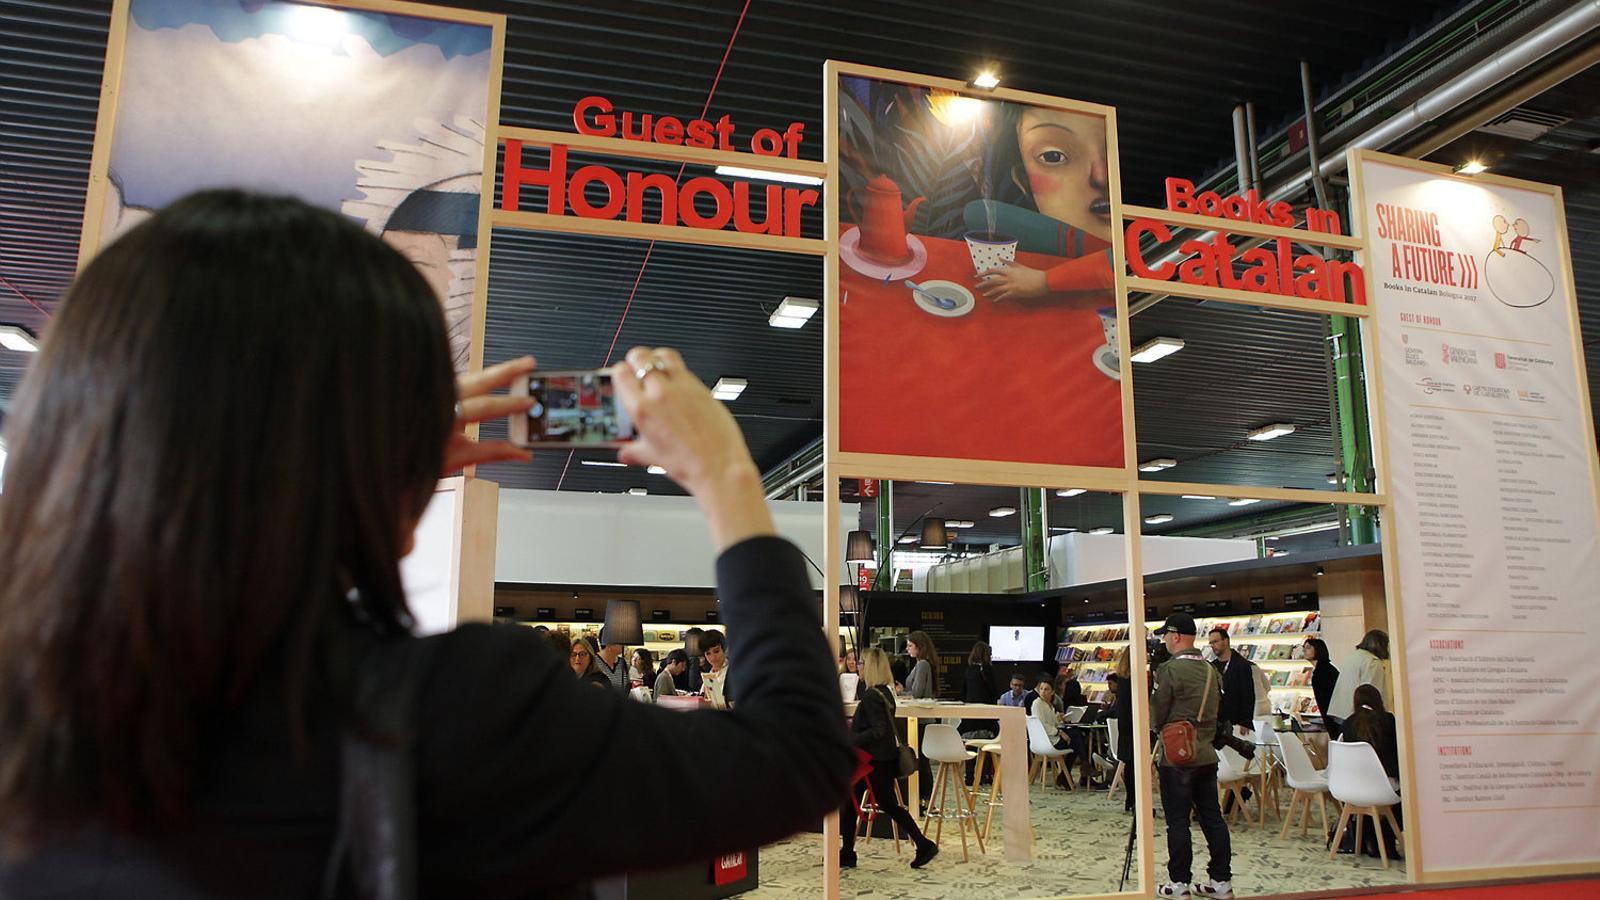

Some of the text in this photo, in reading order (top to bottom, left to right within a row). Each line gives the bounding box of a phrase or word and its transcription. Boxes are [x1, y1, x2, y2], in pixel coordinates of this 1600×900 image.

[573, 96, 805, 160] Guest of
[501, 139, 820, 238] Honour
[1165, 176, 1297, 228] Books
[1376, 203, 1441, 247] SHARING
[1124, 218, 1367, 306] Catalan
[1392, 242, 1457, 287] A FUTURE
[1384, 282, 1403, 292] Books
[1404, 285, 1412, 293] in
[1413, 286, 1438, 296] Catalan
